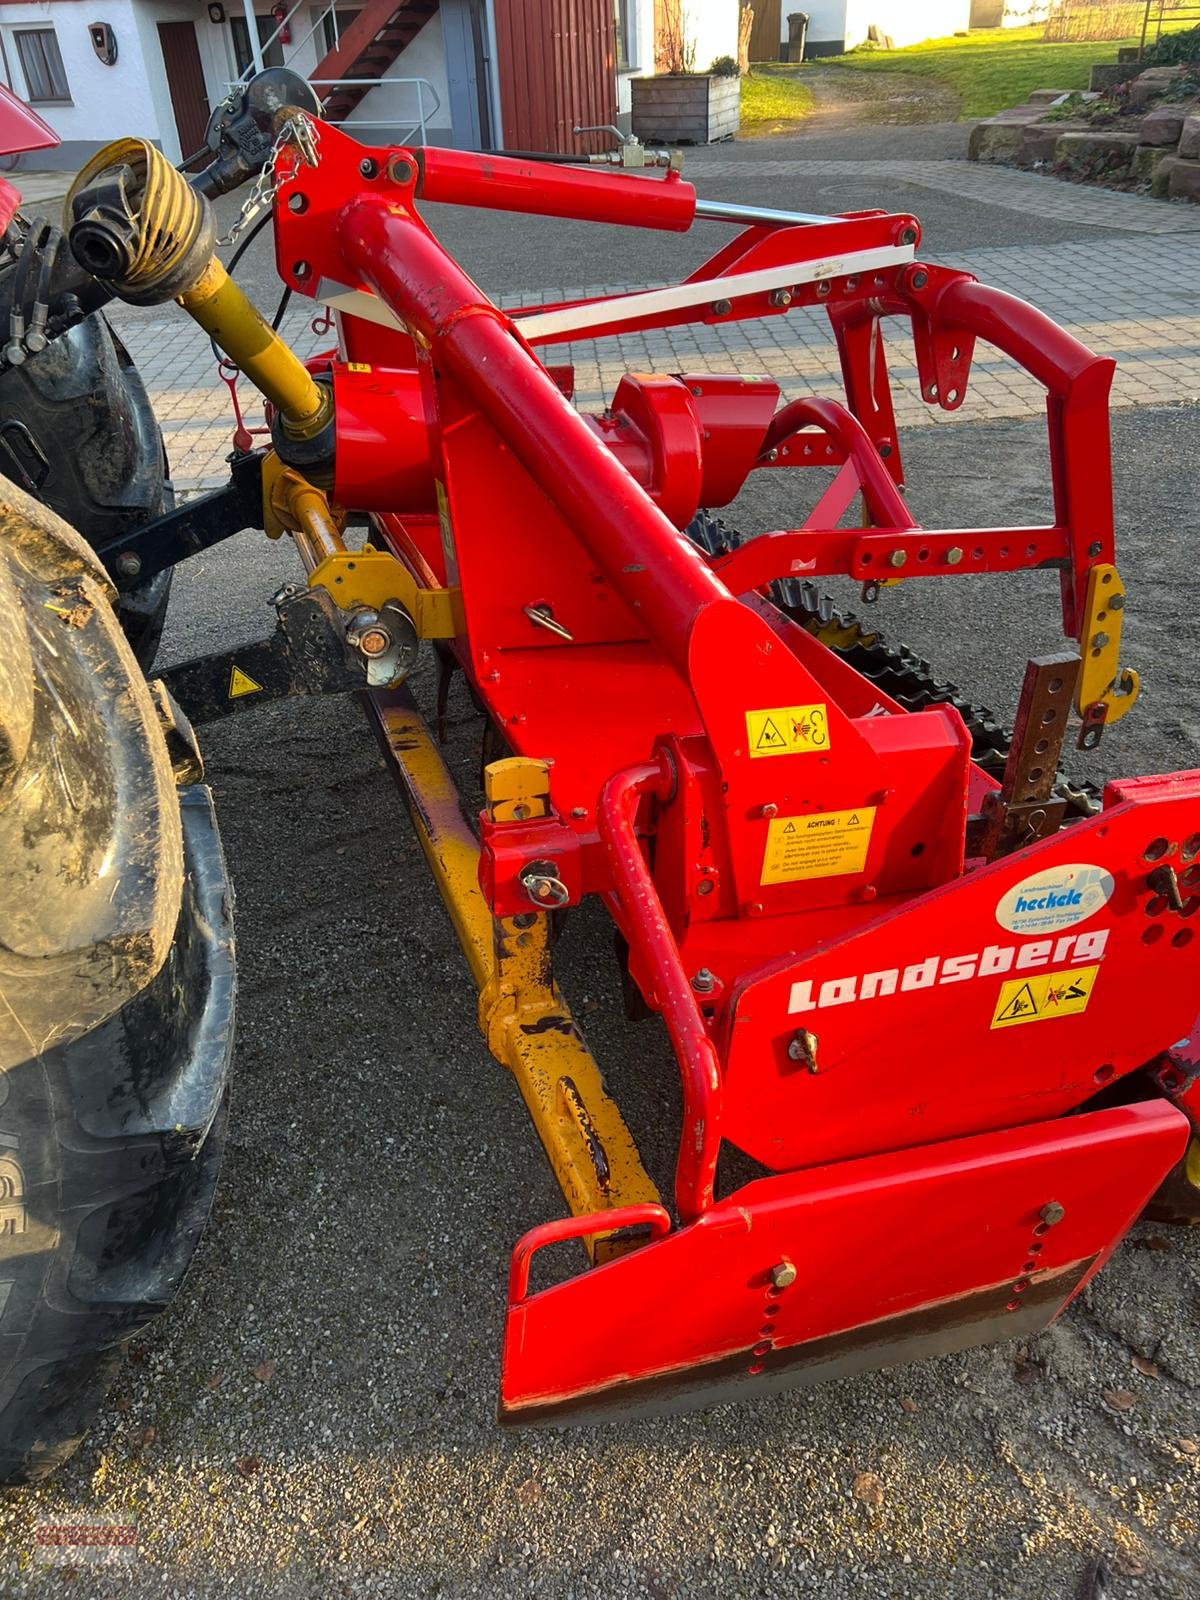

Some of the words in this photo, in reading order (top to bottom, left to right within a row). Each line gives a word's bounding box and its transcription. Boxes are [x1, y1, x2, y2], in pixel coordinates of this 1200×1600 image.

[807, 819, 835, 829] ACHTUNG
[1014, 888, 1083, 913] heckele
[787, 928, 1110, 1015] Landsberg
